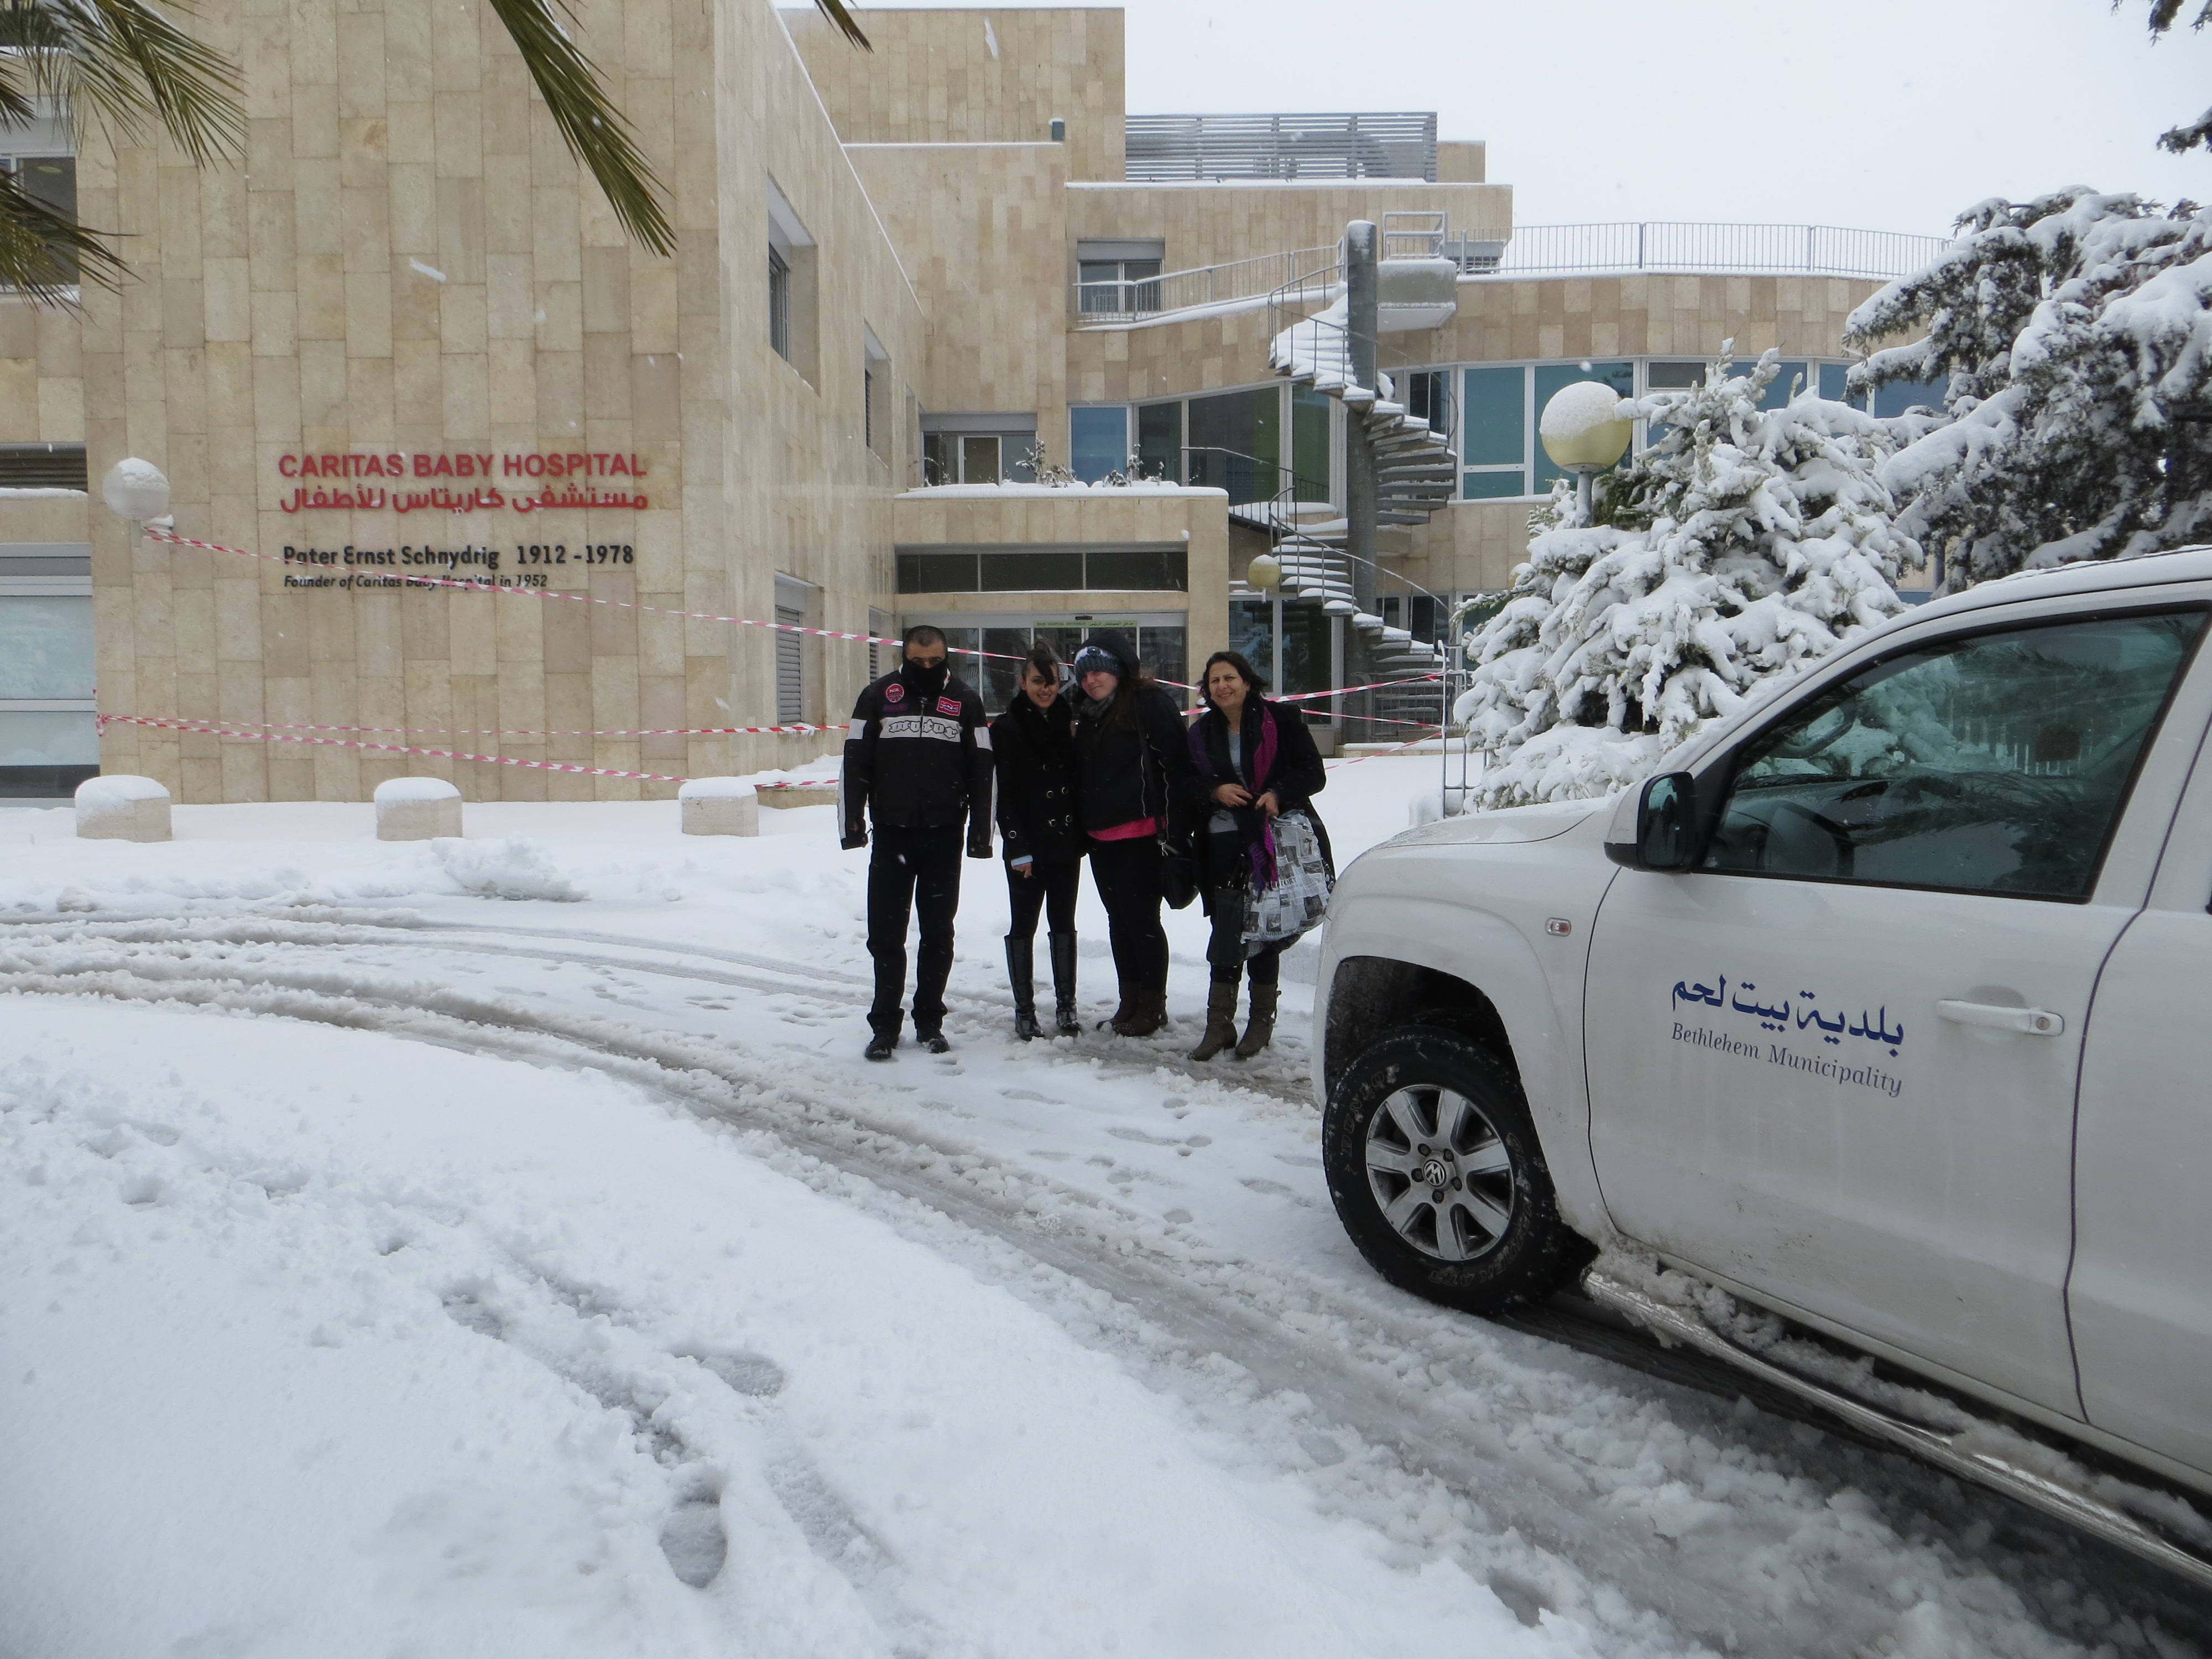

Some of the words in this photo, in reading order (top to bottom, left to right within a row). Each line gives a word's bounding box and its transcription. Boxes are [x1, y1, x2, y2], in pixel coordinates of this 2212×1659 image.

[278, 454, 404, 477] CARITAS
[413, 453, 495, 477] BABY
[503, 453, 648, 476] HOSPITAL
[280, 483, 386, 514] للأطفال
[393, 487, 505, 514] كاريتاس
[512, 483, 648, 513] مستشفى
[283, 546, 337, 565] Pater
[343, 545, 396, 565] Ernst
[401, 544, 500, 570] Schnydrig
[517, 545, 566, 565] 1912
[284, 575, 336, 588] Founder
[339, 575, 354, 591] of
[356, 575, 403, 588] Caritas
[500, 575, 512, 587] in
[517, 574, 547, 587] 1952
[1672, 973, 1727, 1013] لحم
[1731, 982, 1791, 1033] بيت
[1795, 989, 1905, 1058] بلدية
[1671, 1021, 1761, 1060] Bethlehem
[1767, 1044, 1902, 1098] Municipality
